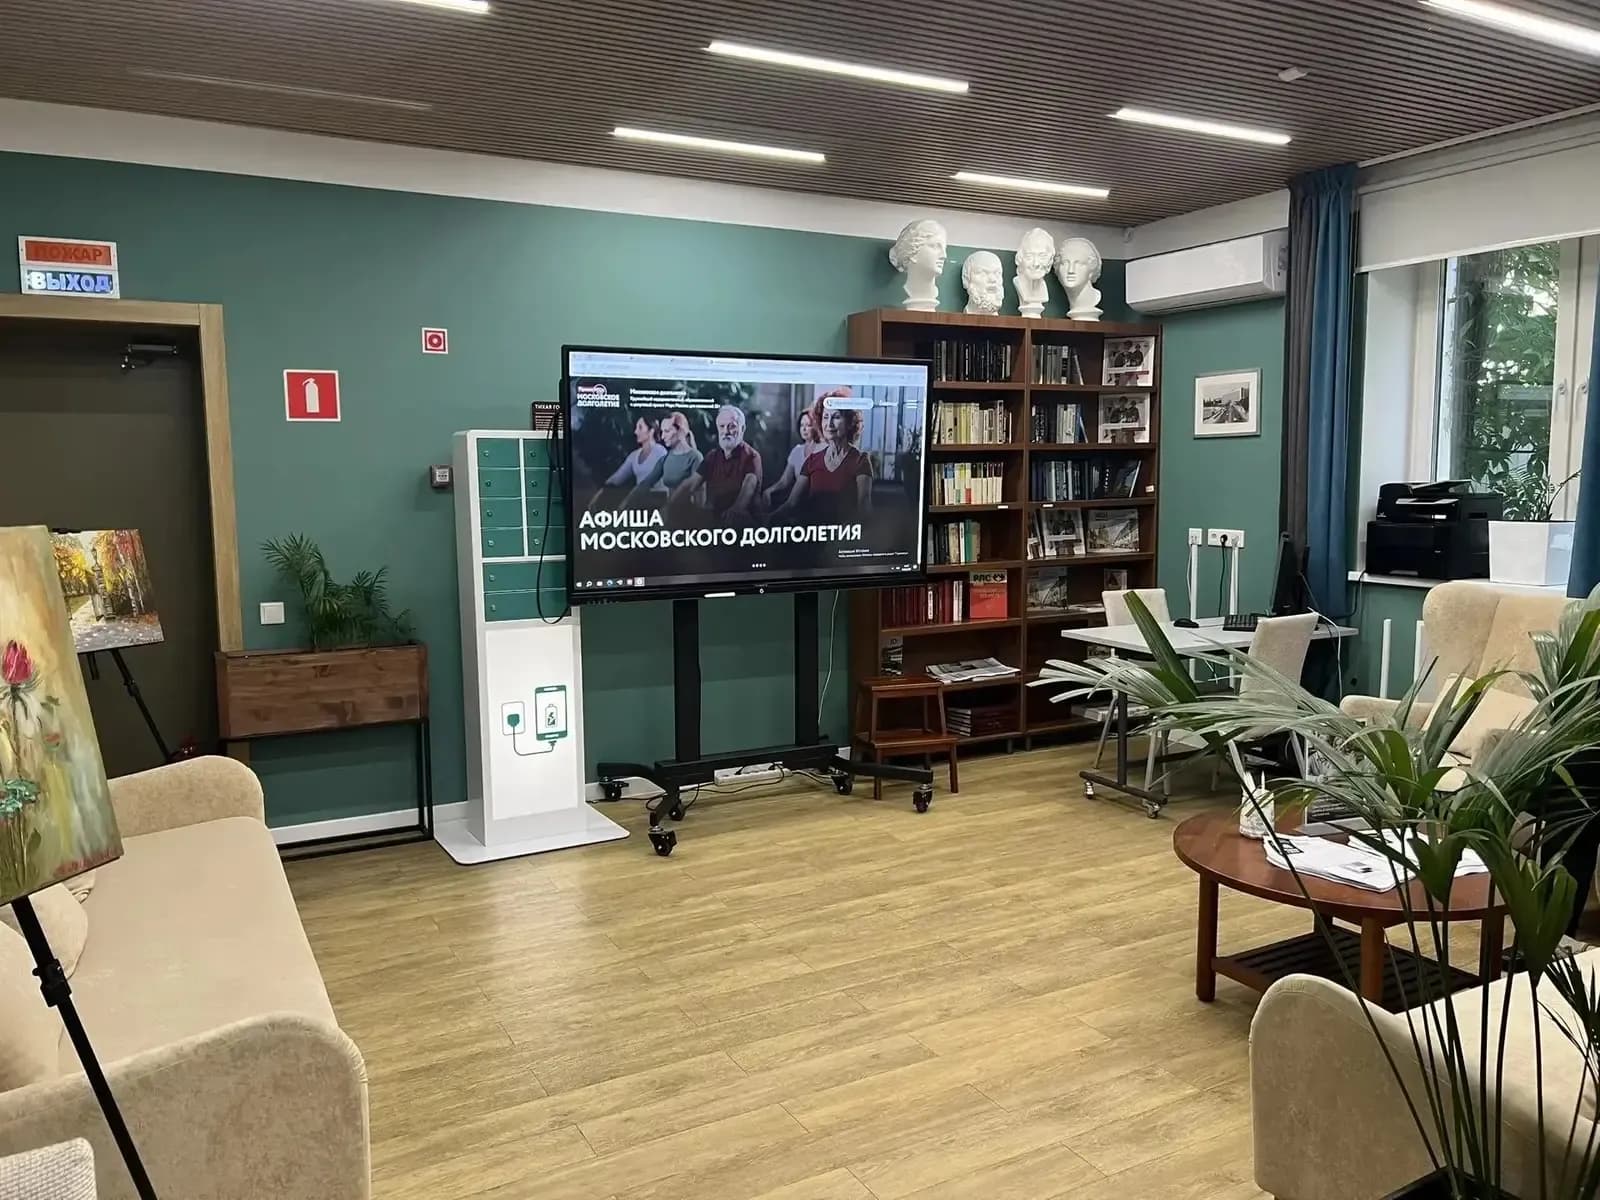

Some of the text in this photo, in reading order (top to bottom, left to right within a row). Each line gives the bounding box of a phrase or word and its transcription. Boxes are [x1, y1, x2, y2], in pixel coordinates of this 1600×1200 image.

[33, 244, 103, 261] ПОЖАР
[30, 271, 111, 293] ВЫХОД
[579, 509, 664, 529] АФИША
[580, 524, 862, 550] МОСКОВСКОГО ДОЛГОЛЕТИЯ
